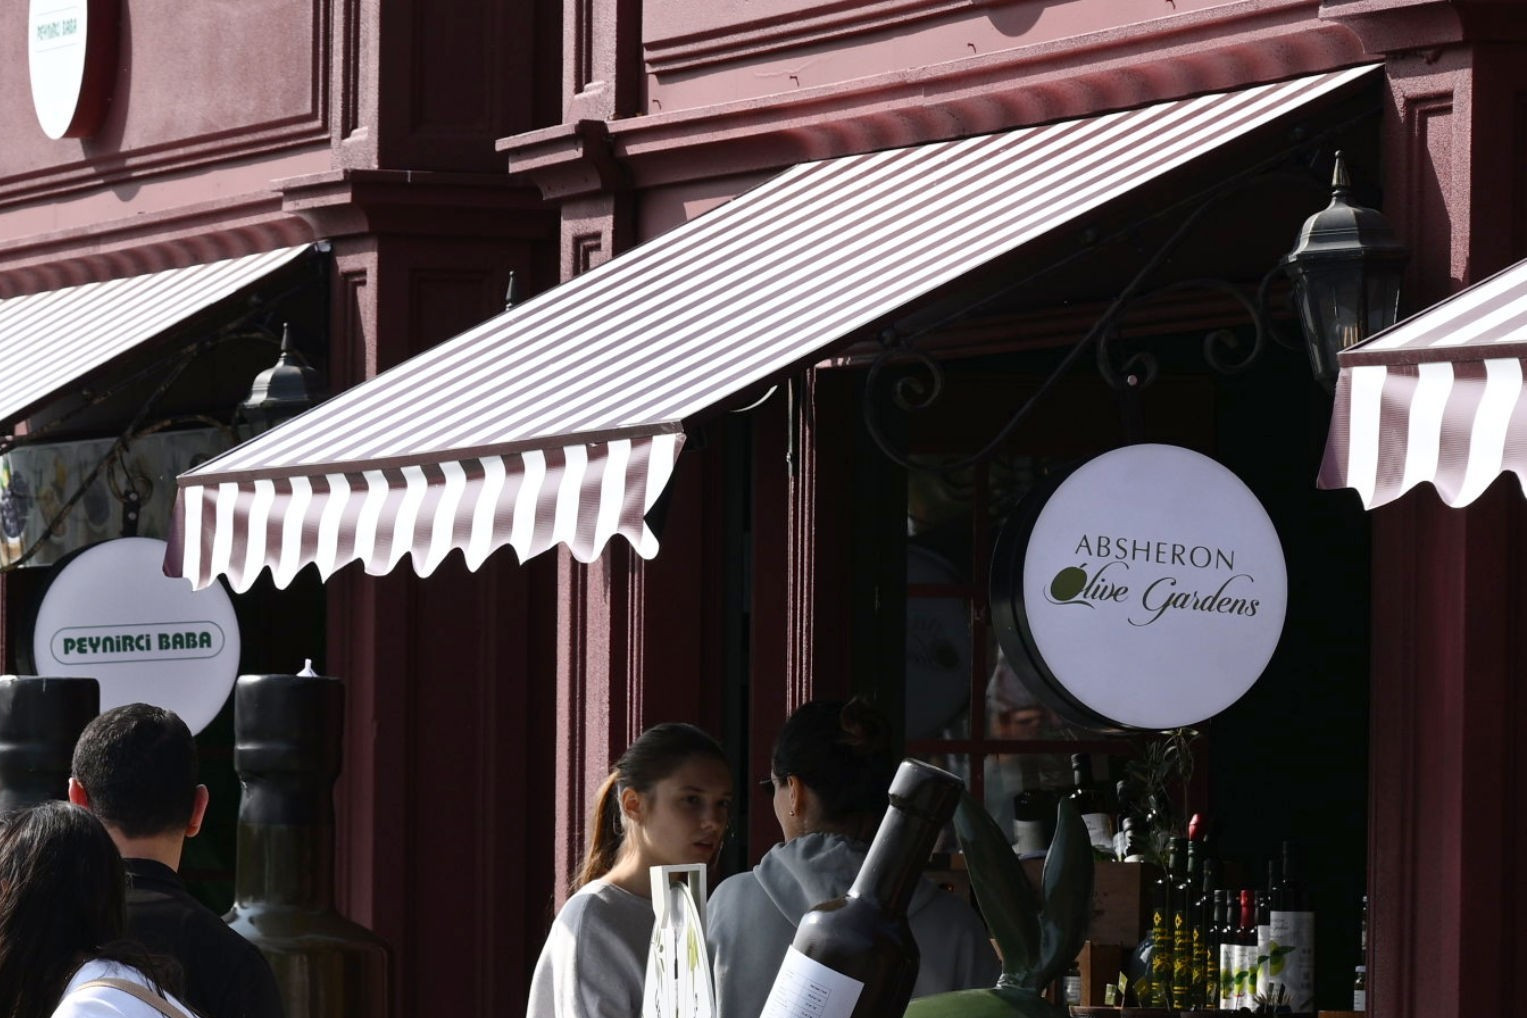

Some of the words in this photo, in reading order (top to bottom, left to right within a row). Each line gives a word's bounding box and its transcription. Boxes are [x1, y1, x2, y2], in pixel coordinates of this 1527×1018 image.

[1075, 534, 1235, 570] ABSHERON
[1128, 574, 1260, 627] Gardens
[158, 631, 212, 650] BABA
